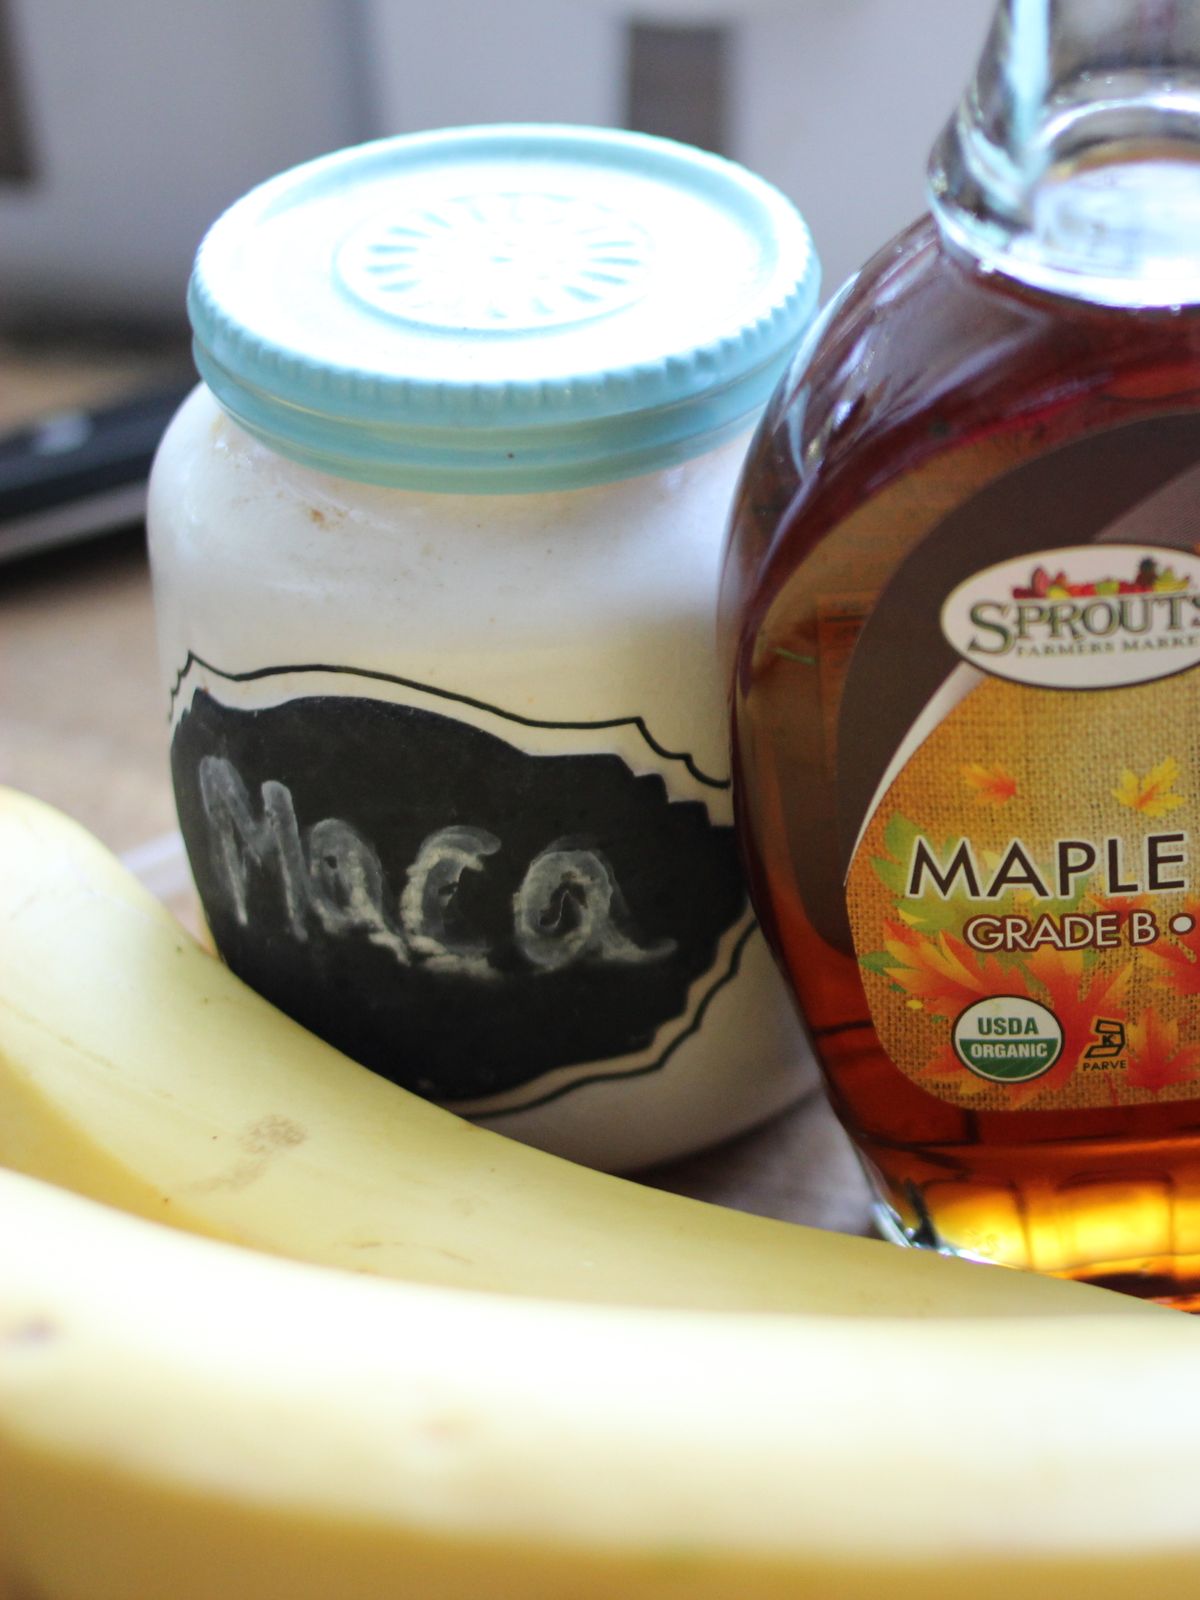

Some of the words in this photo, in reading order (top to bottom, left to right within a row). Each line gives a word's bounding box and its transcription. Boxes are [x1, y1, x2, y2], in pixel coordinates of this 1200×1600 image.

[1017, 641, 1116, 658] FARMERS
[200, 755, 678, 980] Maca
[907, 834, 1187, 899] MAPLE
[966, 912, 1120, 952] GRADE
[1130, 911, 1157, 945] B
[977, 1017, 1039, 1036] USDA
[970, 1042, 1048, 1059] ORGANIC
[1082, 1059, 1127, 1071] PARVE
